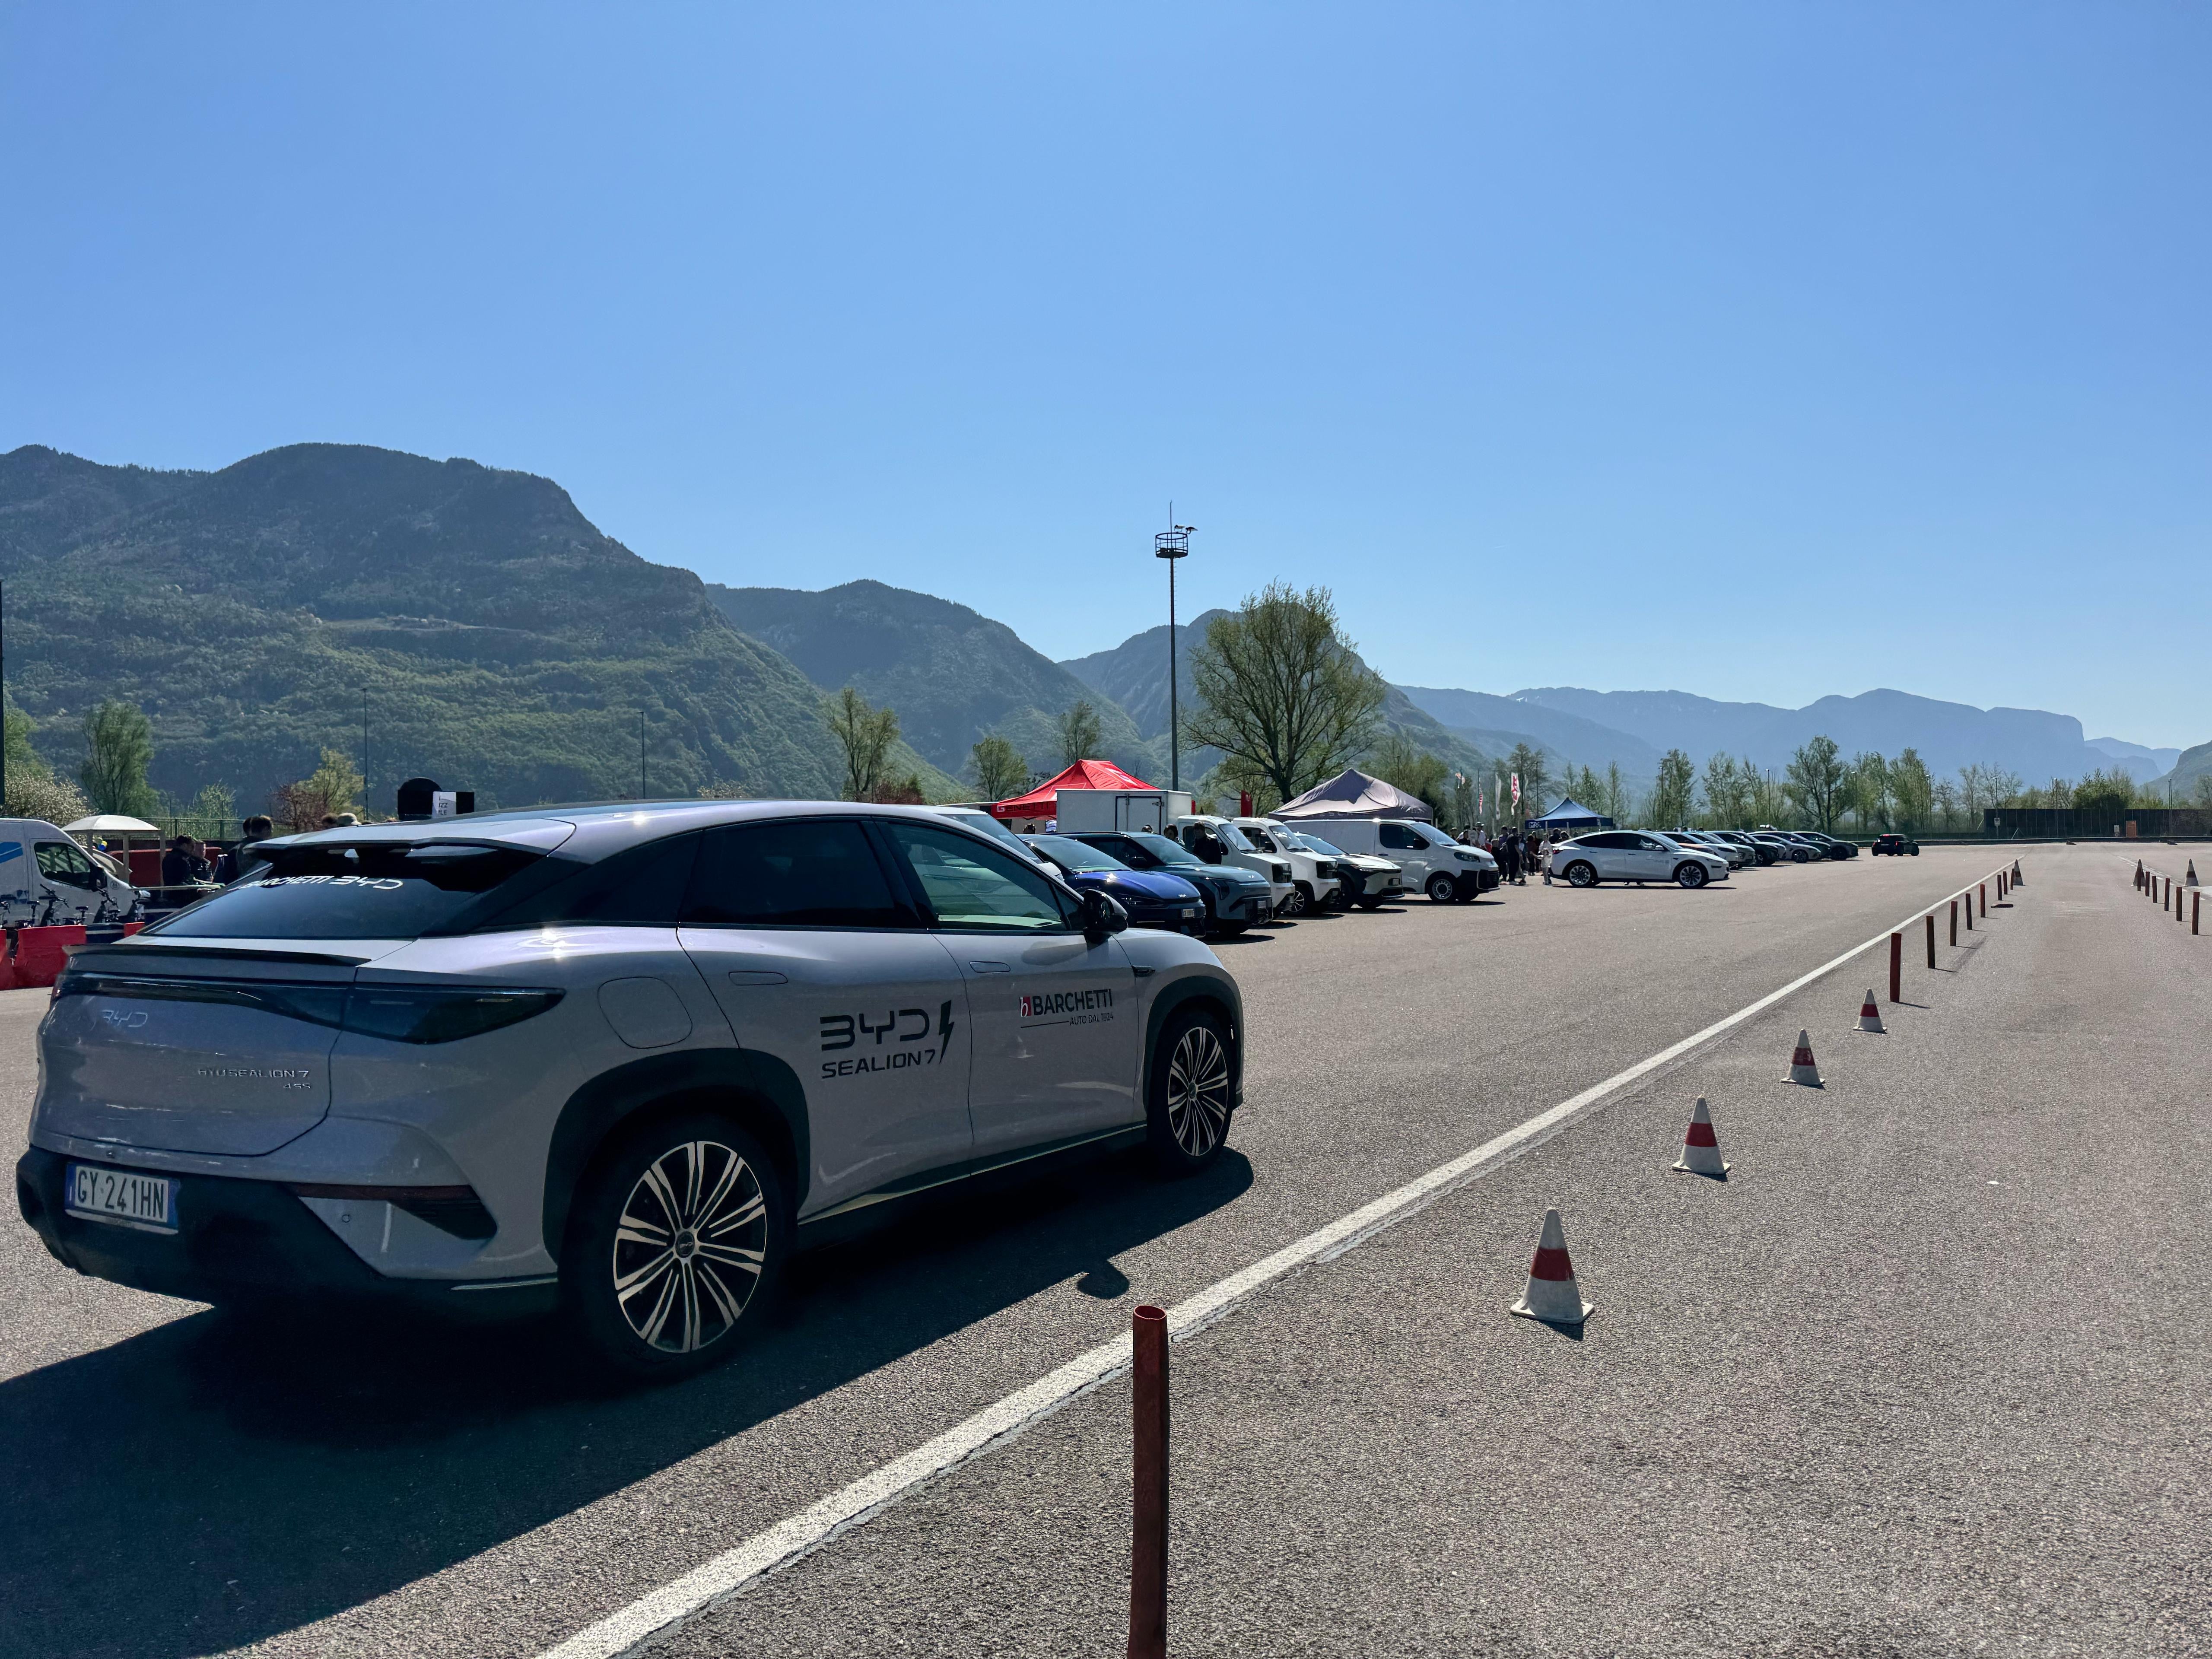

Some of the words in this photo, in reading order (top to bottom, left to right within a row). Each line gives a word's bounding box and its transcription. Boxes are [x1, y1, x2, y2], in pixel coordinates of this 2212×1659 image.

[329, 876, 404, 890] BYD
[1032, 988, 1112, 1016] BARCHETTI
[820, 1008, 930, 1051] BYD
[1070, 1015, 1087, 1026] AUTO
[1088, 1014, 1100, 1023] DAL
[822, 1051, 921, 1079] SEALION
[925, 1049, 935, 1064] 7
[105, 1175, 164, 1219] 241HN
